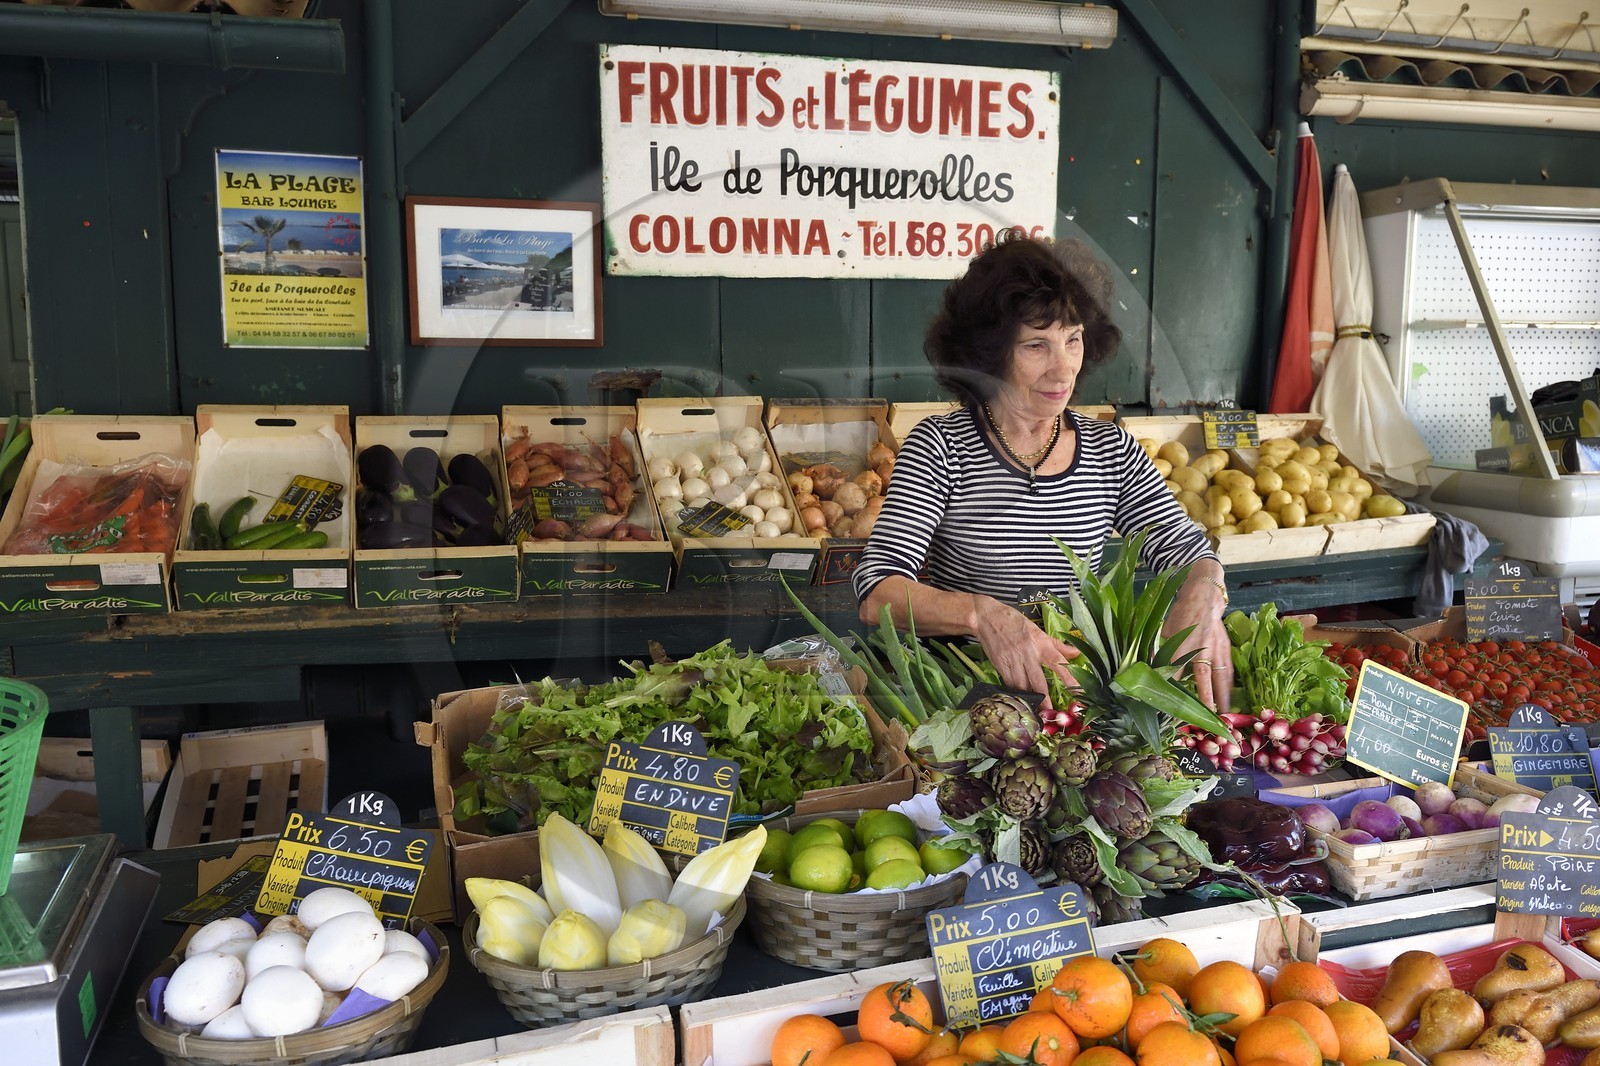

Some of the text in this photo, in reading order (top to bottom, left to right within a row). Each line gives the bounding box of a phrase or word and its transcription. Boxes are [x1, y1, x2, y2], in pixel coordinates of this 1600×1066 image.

[617, 60, 785, 129] FRUITS
[792, 86, 820, 130] et
[224, 171, 356, 194] LA PLAGE
[722, 149, 763, 195] de
[780, 147, 1014, 209] Porquerolles
[240, 196, 337, 209] BAR LOUNGE
[459, 232, 553, 250] Bar La Plage
[628, 214, 831, 256] COLONNA
[255, 282, 270, 293] de
[274, 283, 356, 296] Porquerolles
[1220, 400, 1234, 409] 1Kg
[532, 488, 550, 497] Prix
[1499, 562, 1521, 577] 1kg
[1496, 598, 1538, 610] Tomate
[1371, 694, 1393, 716] Rond
[1386, 680, 1438, 708] NAVET
[1371, 707, 1402, 727] FRANCE
[1517, 706, 1543, 724] 1Kg
[661, 724, 693, 746] 1Kg
[1489, 732, 1515, 753] Prix
[605, 742, 734, 788] Prix 4,80 €
[1179, 756, 1205, 774] Pièce
[1191, 751, 1200, 764] la
[1415, 749, 1440, 767] Euros
[1513, 758, 1588, 773] GINGEMBRE
[599, 776, 625, 797] Produit
[347, 792, 384, 816] 1Kg
[596, 800, 695, 831] Variété Calibre
[283, 812, 428, 862] Prix 6,50 €
[666, 830, 697, 853] Catégorie
[1502, 824, 1537, 846] Prix
[274, 849, 416, 894] Produit Champignon
[1501, 855, 1535, 871] Produit
[267, 873, 295, 895] Variété
[980, 864, 1019, 891] 1Kg
[258, 892, 289, 914] Origine
[1498, 895, 1525, 912] Origine
[930, 891, 1081, 943] Prix 5,00 €
[938, 953, 970, 977] Produit
[943, 982, 973, 1002] Variété
[979, 972, 1024, 993] Feuille
